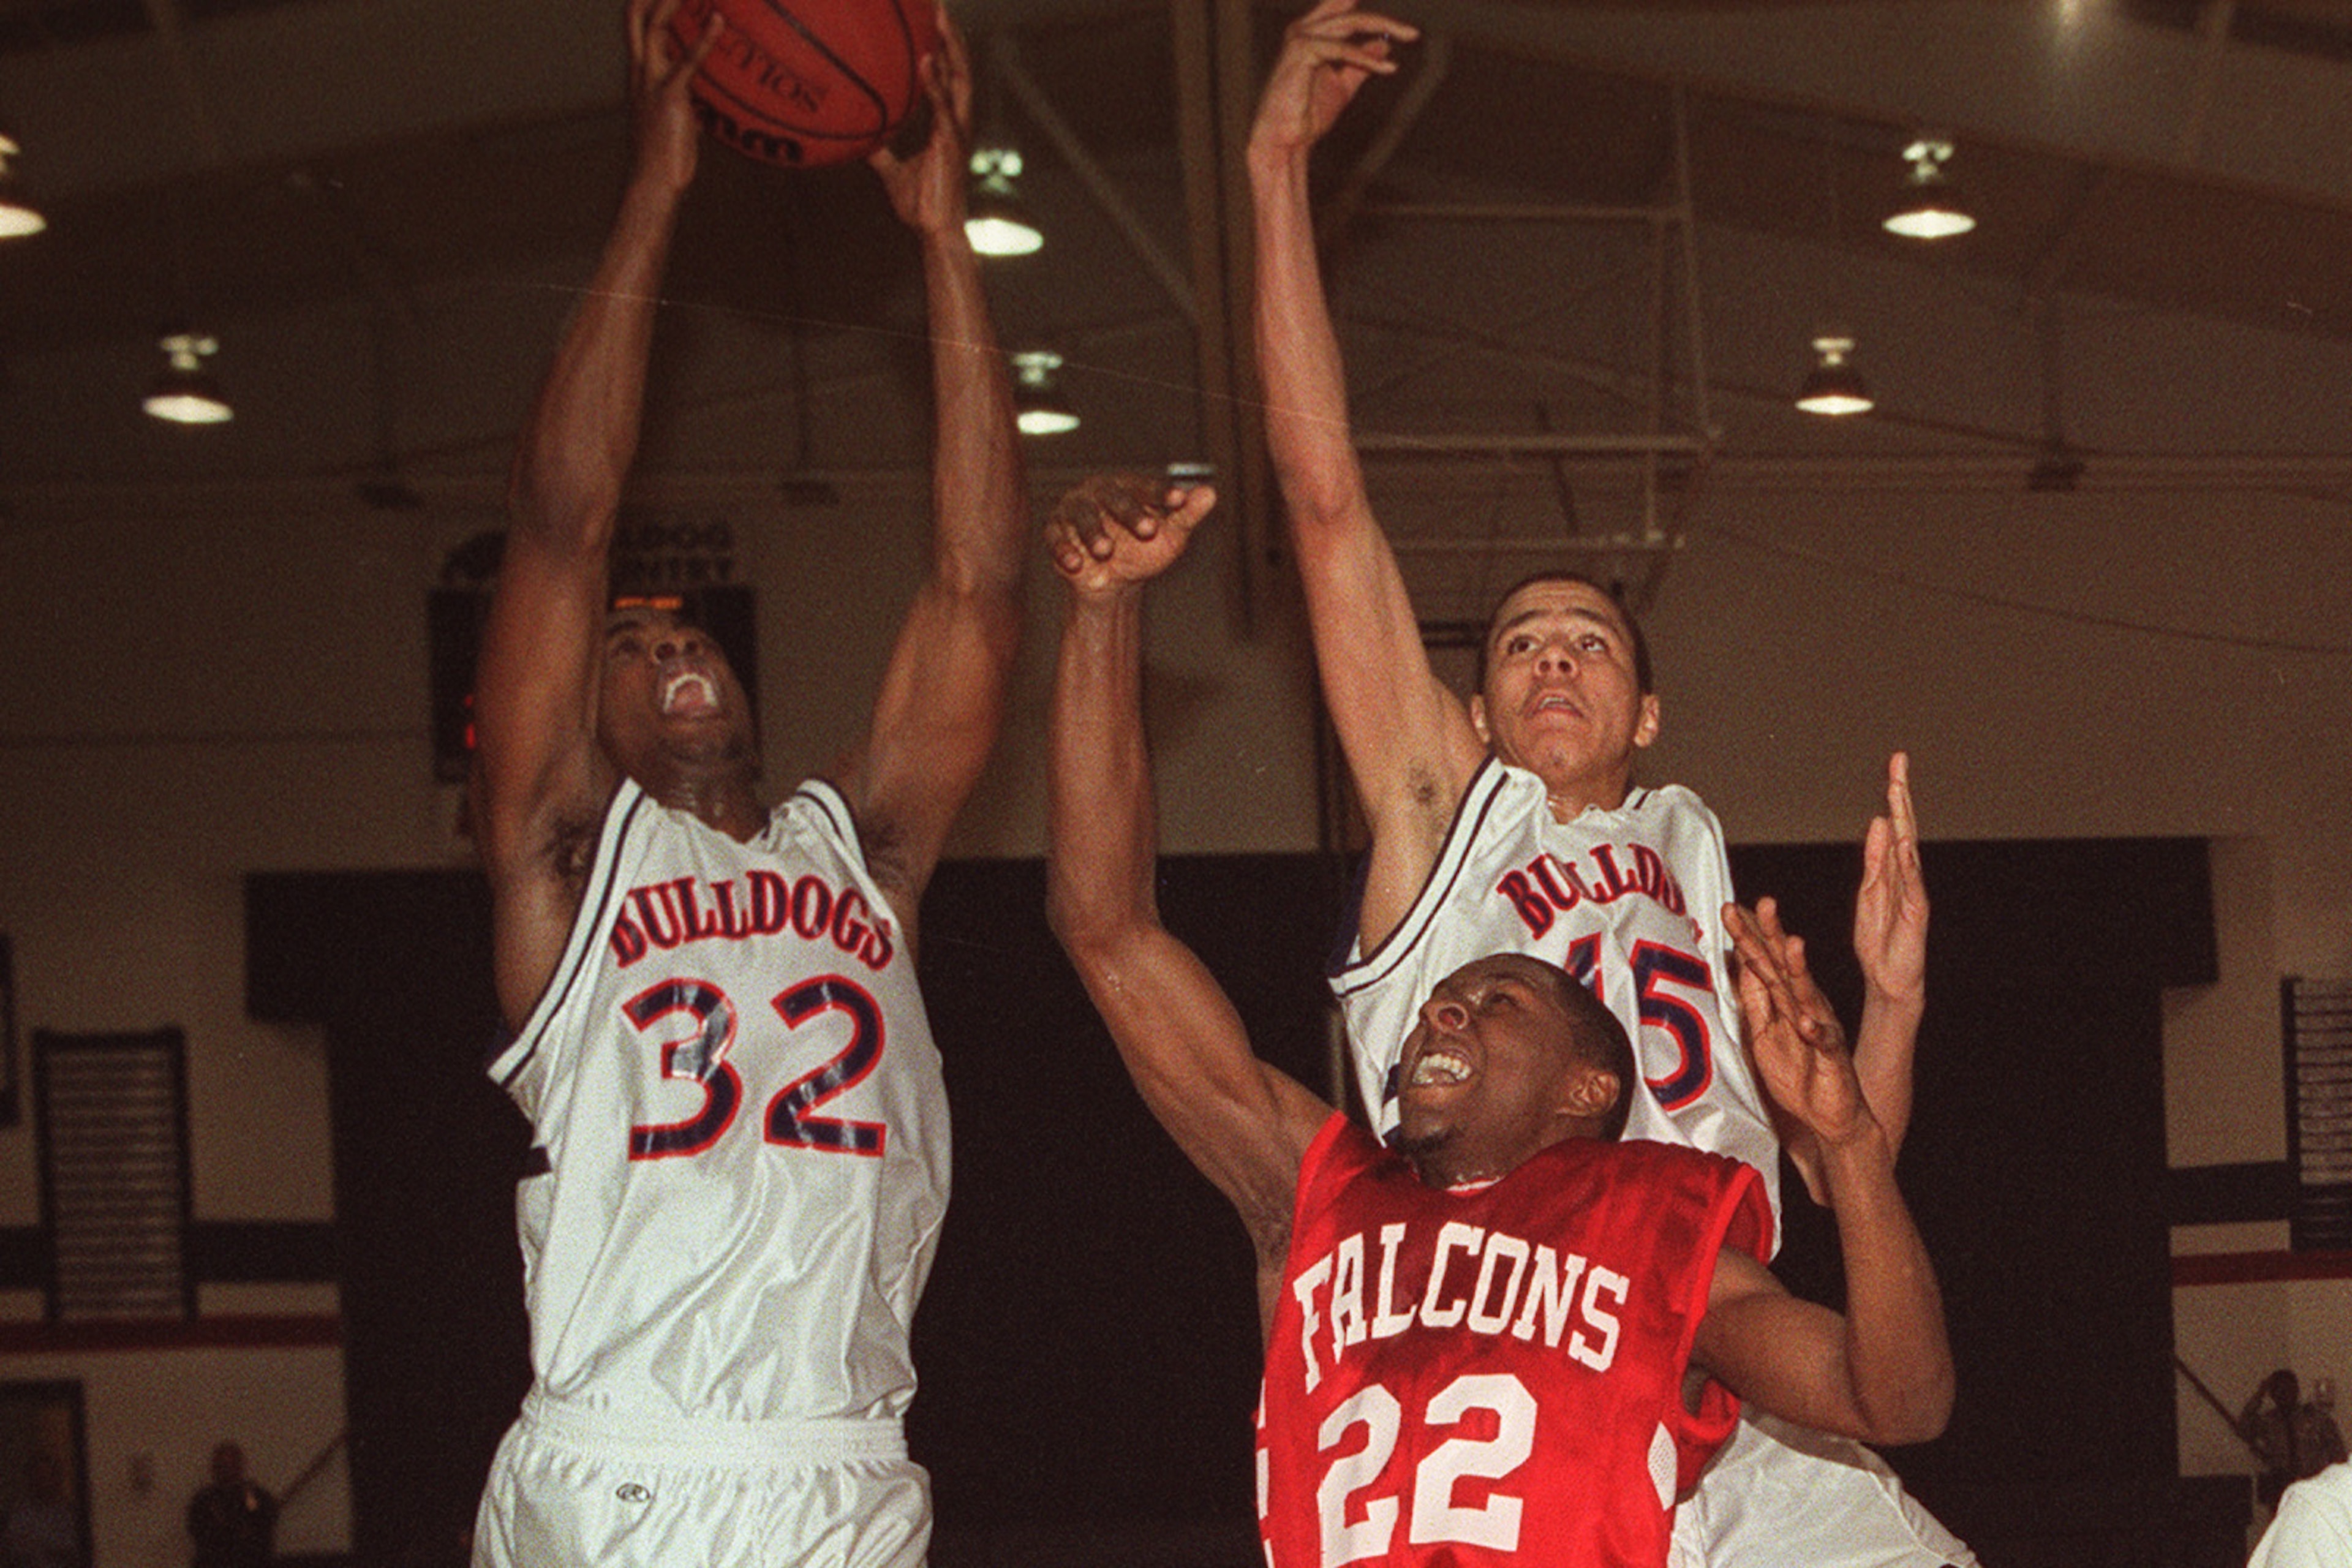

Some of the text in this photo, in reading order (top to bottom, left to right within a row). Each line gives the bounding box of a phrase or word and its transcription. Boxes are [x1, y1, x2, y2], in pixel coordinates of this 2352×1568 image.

[622, 974, 887, 1161] 32
[1293, 1221, 1630, 1395] FALCONS
[1316, 1374, 1537, 1568] 22
